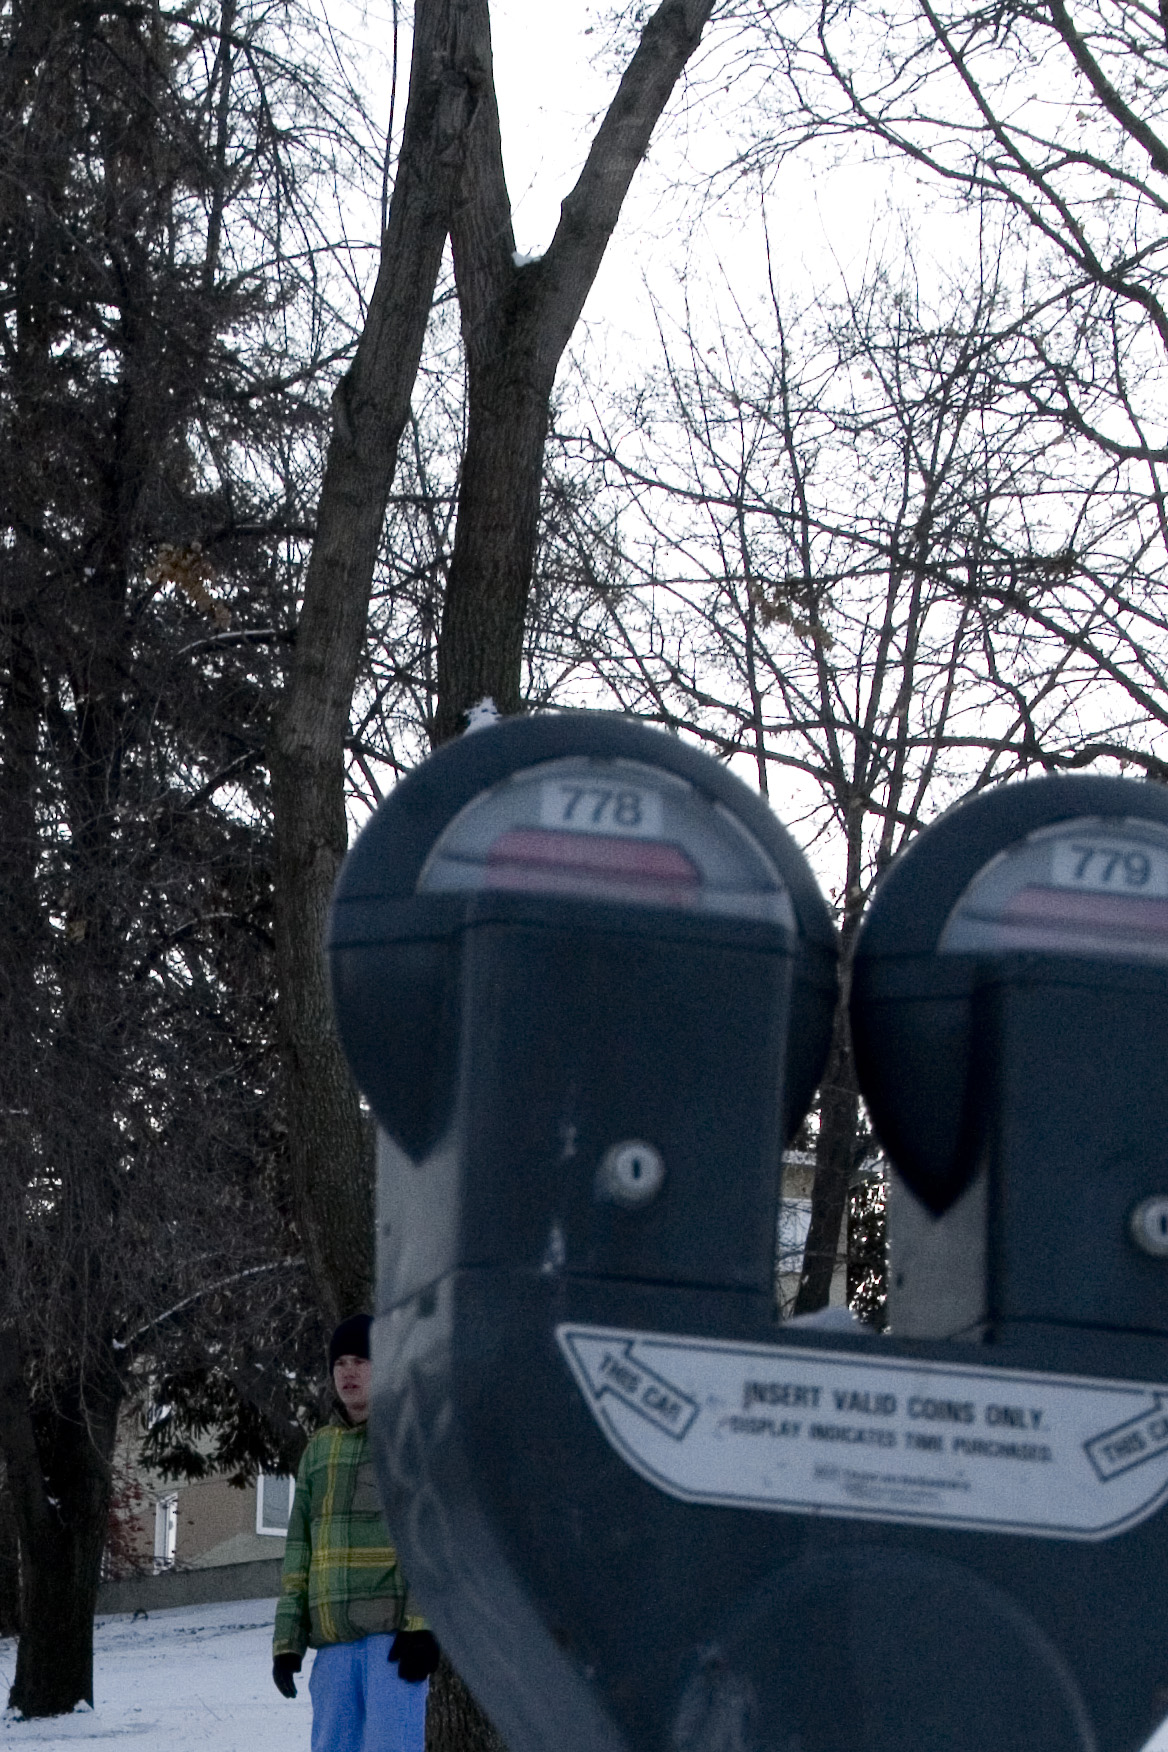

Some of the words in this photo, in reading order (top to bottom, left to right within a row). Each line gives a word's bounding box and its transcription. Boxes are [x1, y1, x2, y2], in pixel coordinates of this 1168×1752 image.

[560, 786, 642, 826] 778
[1071, 844, 1151, 886] 779
[599, 1351, 640, 1394] THIS
[743, 1379, 821, 1408] INSERT
[833, 1389, 897, 1416] VALID
[907, 1396, 975, 1425] COINS
[730, 1414, 801, 1438] DISPLAY
[809, 1421, 897, 1448] INDICATES
[905, 1431, 943, 1453] TIME
[1101, 1430, 1147, 1464] THIS
